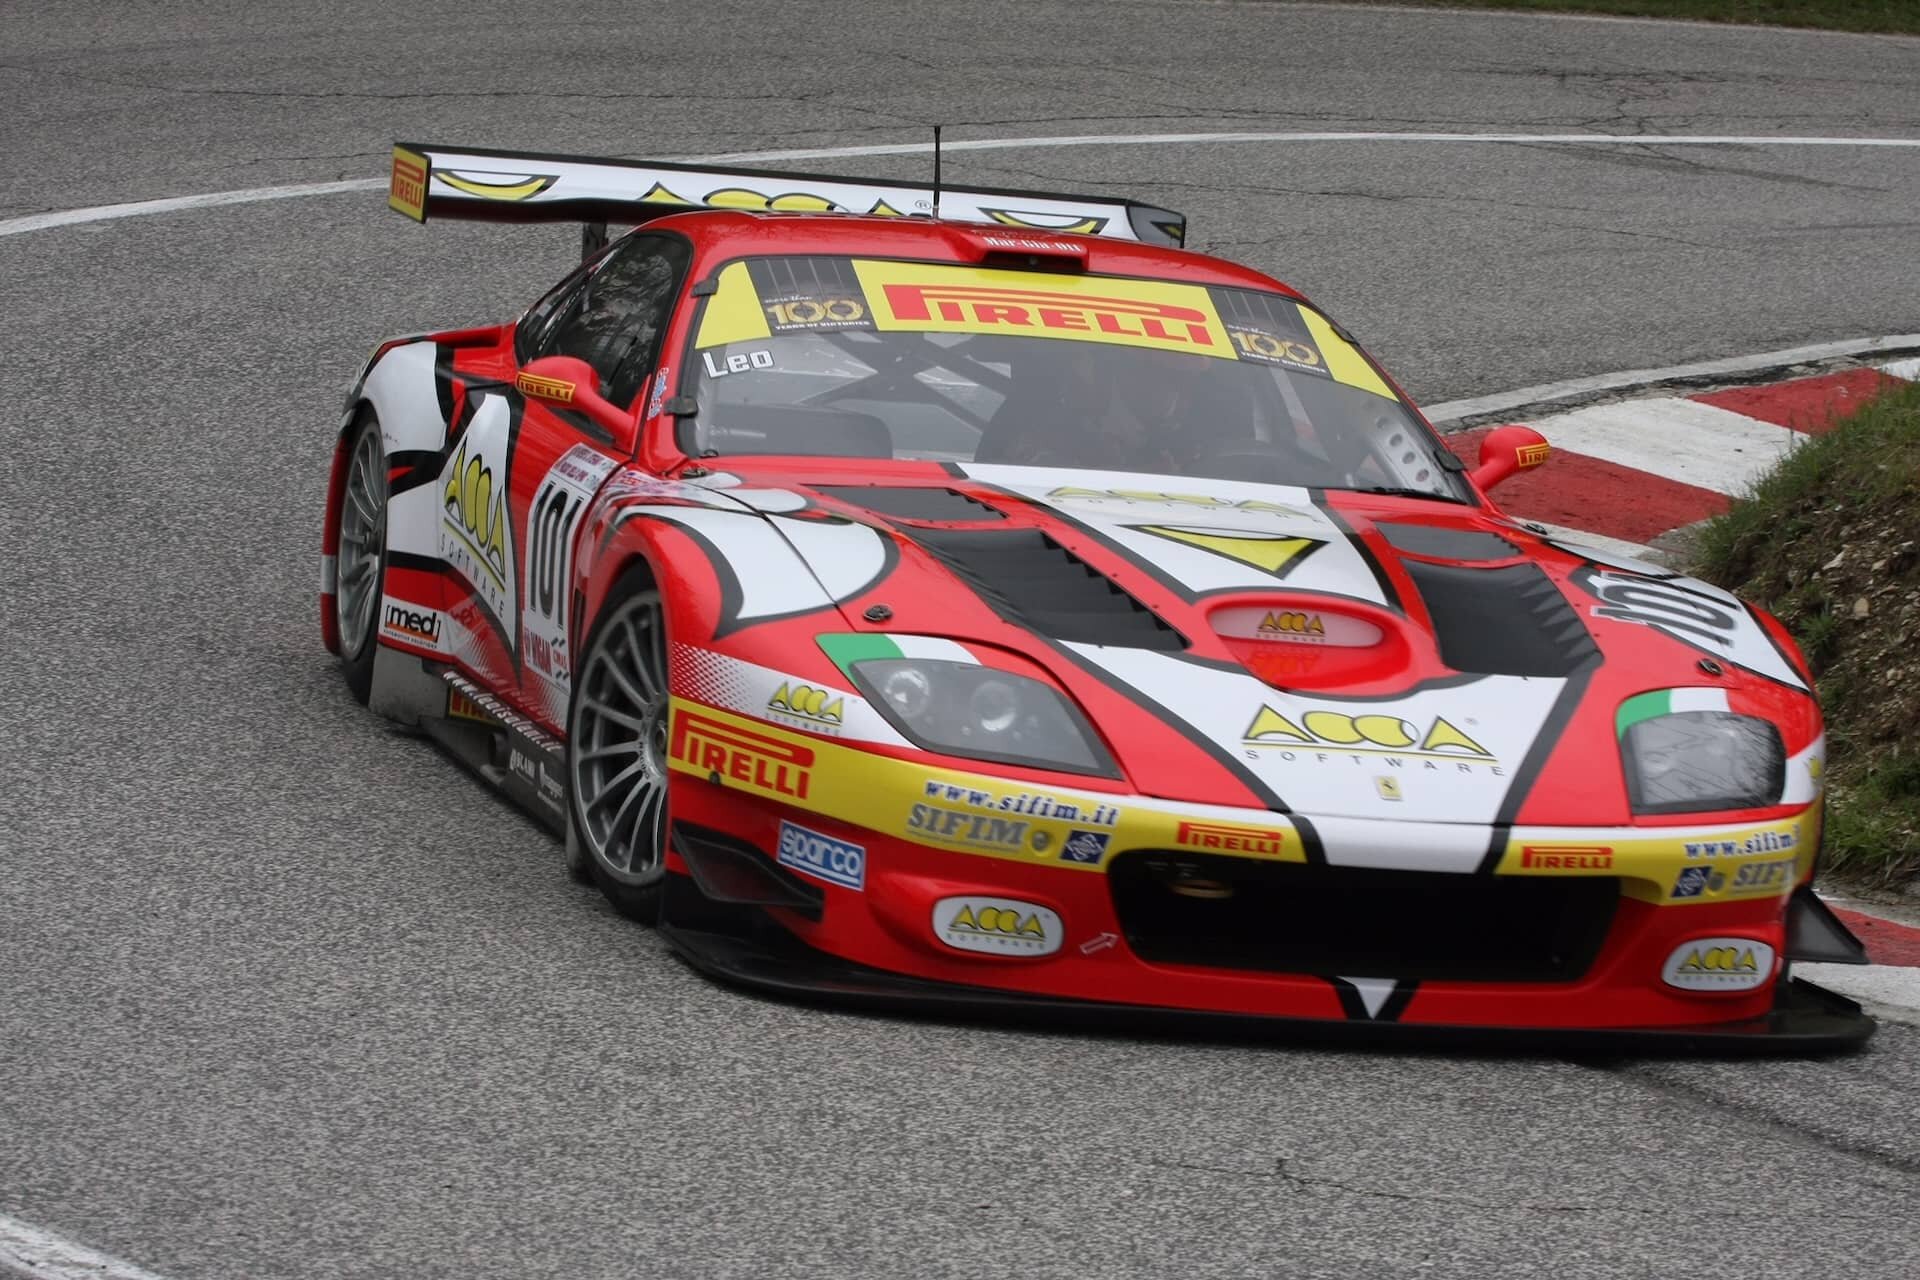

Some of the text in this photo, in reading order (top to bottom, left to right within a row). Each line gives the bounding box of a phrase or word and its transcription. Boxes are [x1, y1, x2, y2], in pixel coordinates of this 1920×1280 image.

[392, 158, 425, 209] PIRELLI
[766, 299, 864, 325] 100
[881, 283, 1215, 346] PIRELLI
[702, 349, 774, 379] Leo
[1230, 331, 1320, 366] 100
[518, 374, 574, 401] PIRELLI
[441, 533, 506, 619] SOFTWARE
[529, 480, 584, 631] 101
[1258, 611, 1326, 635] ACCA
[1593, 570, 1740, 648] 101
[767, 681, 844, 723] ACCA
[1242, 703, 1495, 757] ACCA
[670, 708, 815, 800] PIRELLI
[1245, 749, 1506, 777] SOFTWARE
[908, 803, 1029, 845] SIFIM
[924, 780, 1119, 827] www.sifim.it
[781, 826, 862, 877] sparco
[1177, 821, 1282, 855] PIRELLI
[1520, 846, 1614, 869] PIRELLI
[949, 904, 1047, 939] ACCA
[1678, 946, 1759, 971] ACCA
